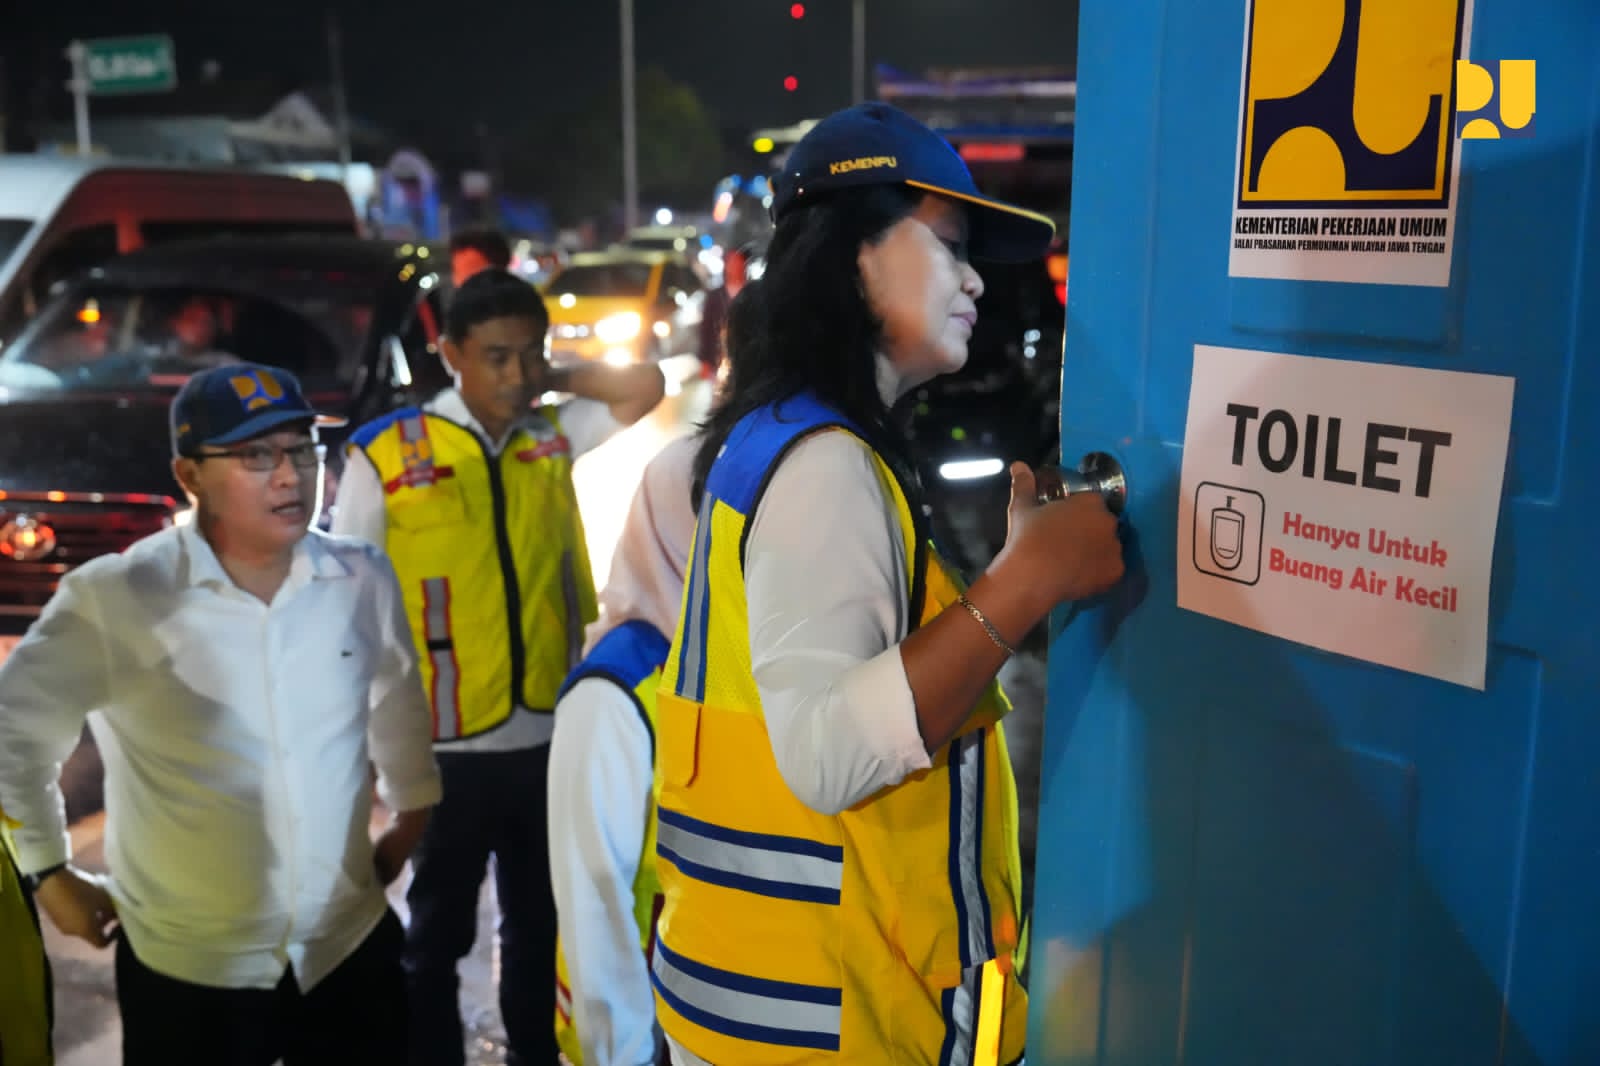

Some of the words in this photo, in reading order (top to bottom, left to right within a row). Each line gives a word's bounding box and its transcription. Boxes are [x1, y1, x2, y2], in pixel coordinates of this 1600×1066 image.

[829, 156, 897, 175] KEMENPU
[1235, 217, 1318, 235] KEMENTERIAN
[1321, 217, 1396, 236] PEKERJAAN
[1399, 217, 1447, 237] UMUM
[1254, 239, 1297, 250] PRASARANA
[1298, 240, 1349, 251] PERMUKIMAN
[1351, 241, 1386, 252] WILAYAH
[1387, 241, 1410, 253] JAWA
[1412, 242, 1445, 253] TENGAH
[1226, 403, 1452, 498] TOILET
[1282, 511, 1361, 549] Hanya
[1367, 528, 1448, 568] Untuk
[1269, 548, 1343, 590] Buang
[1349, 567, 1387, 596] Air
[1394, 576, 1457, 613] Kecil
